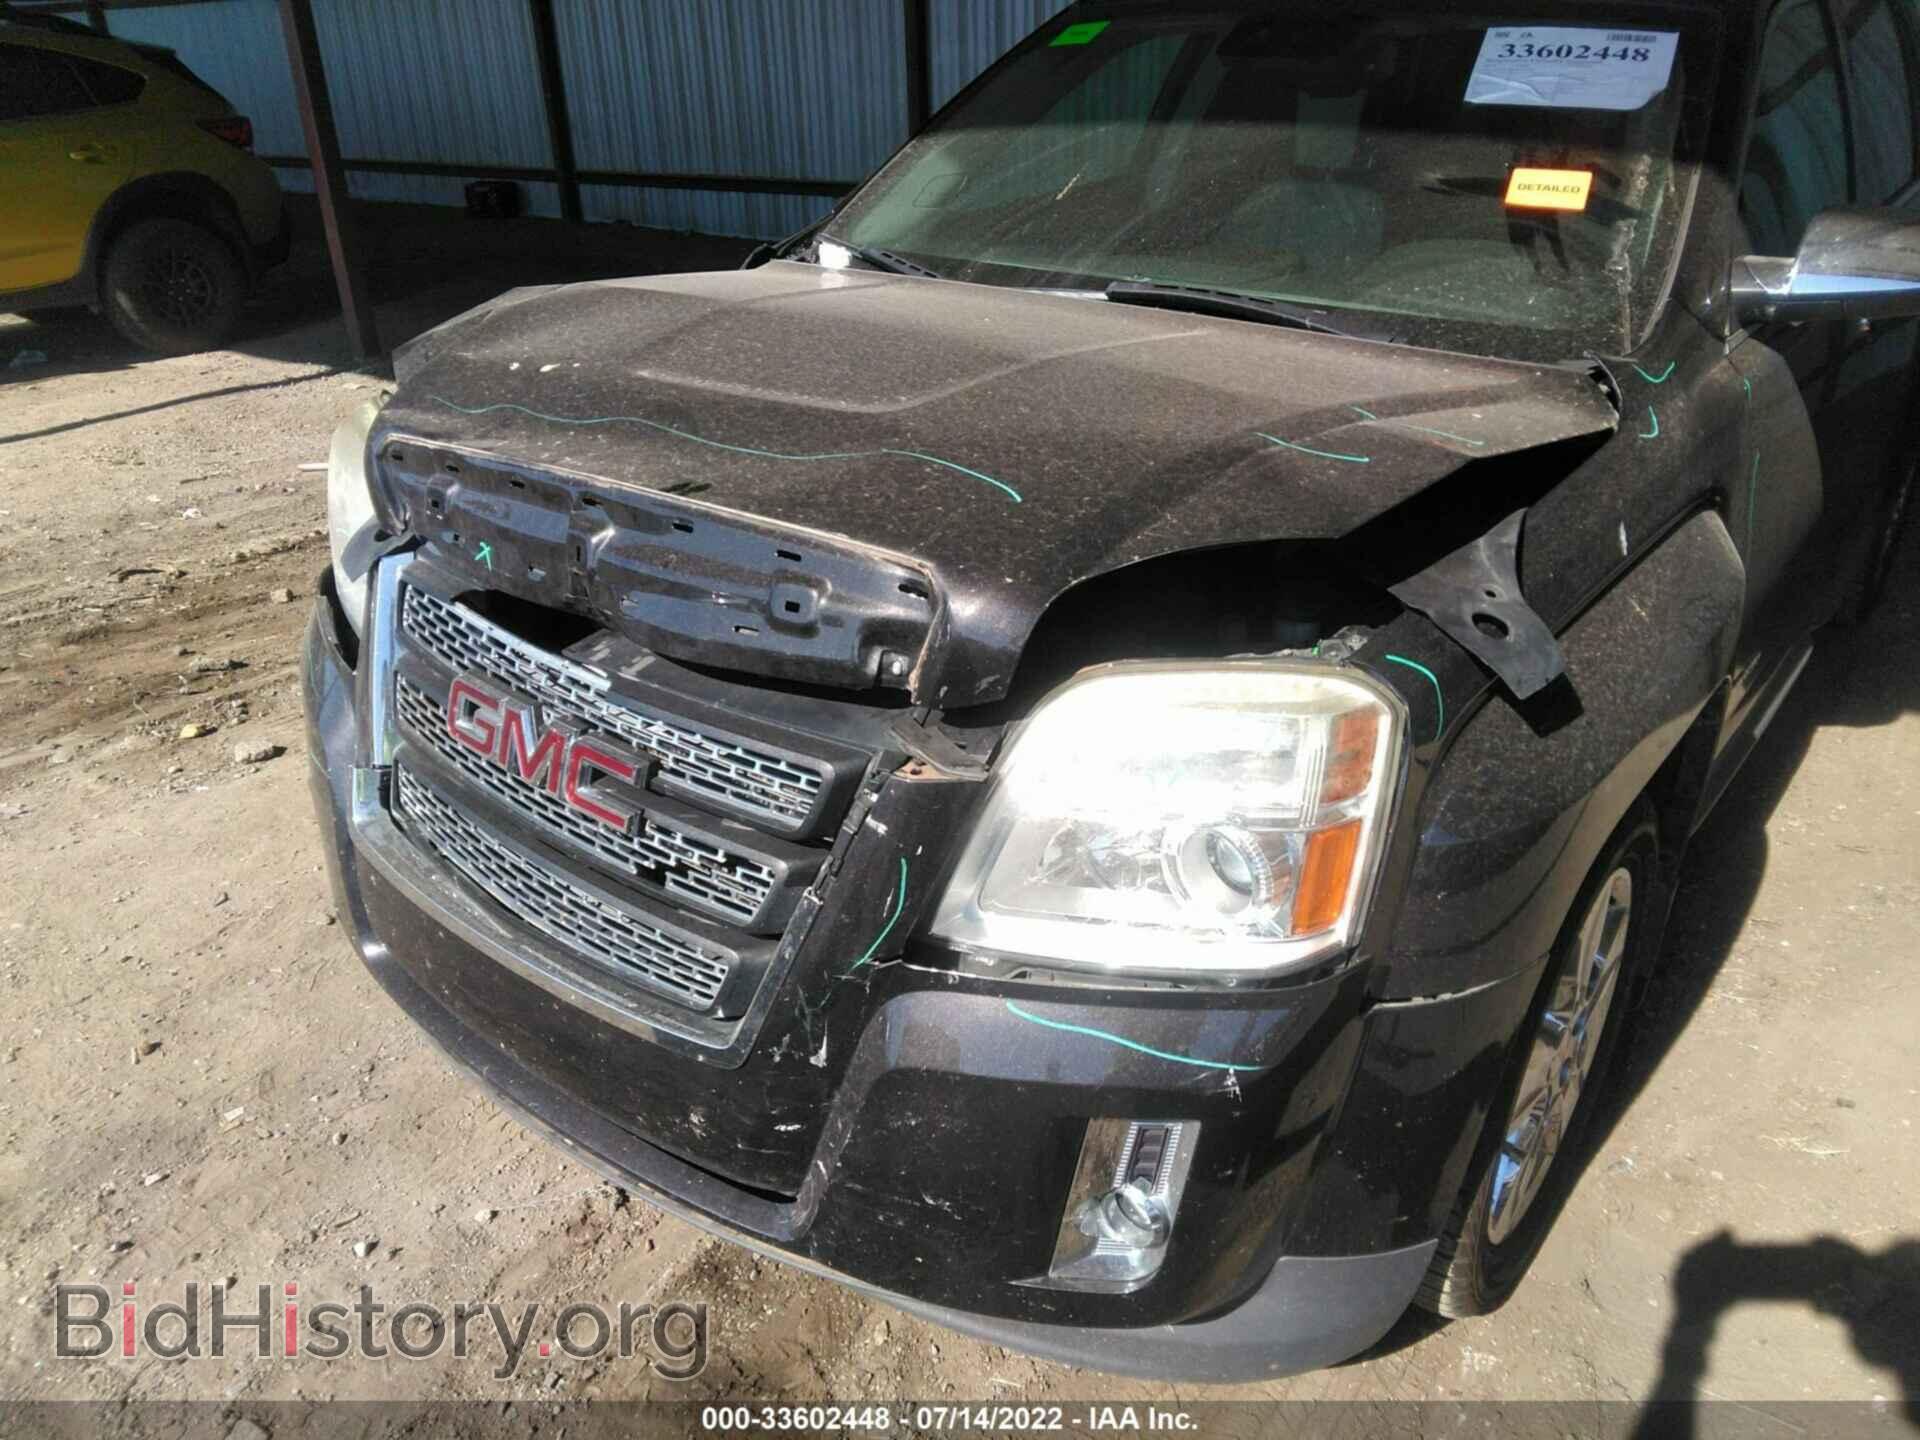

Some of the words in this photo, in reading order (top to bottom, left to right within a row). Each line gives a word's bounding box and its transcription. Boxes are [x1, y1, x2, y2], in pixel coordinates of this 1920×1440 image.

[1497, 43, 1651, 62] 33602448
[1517, 183, 1581, 194] DETAILED
[446, 677, 643, 834] GMC
